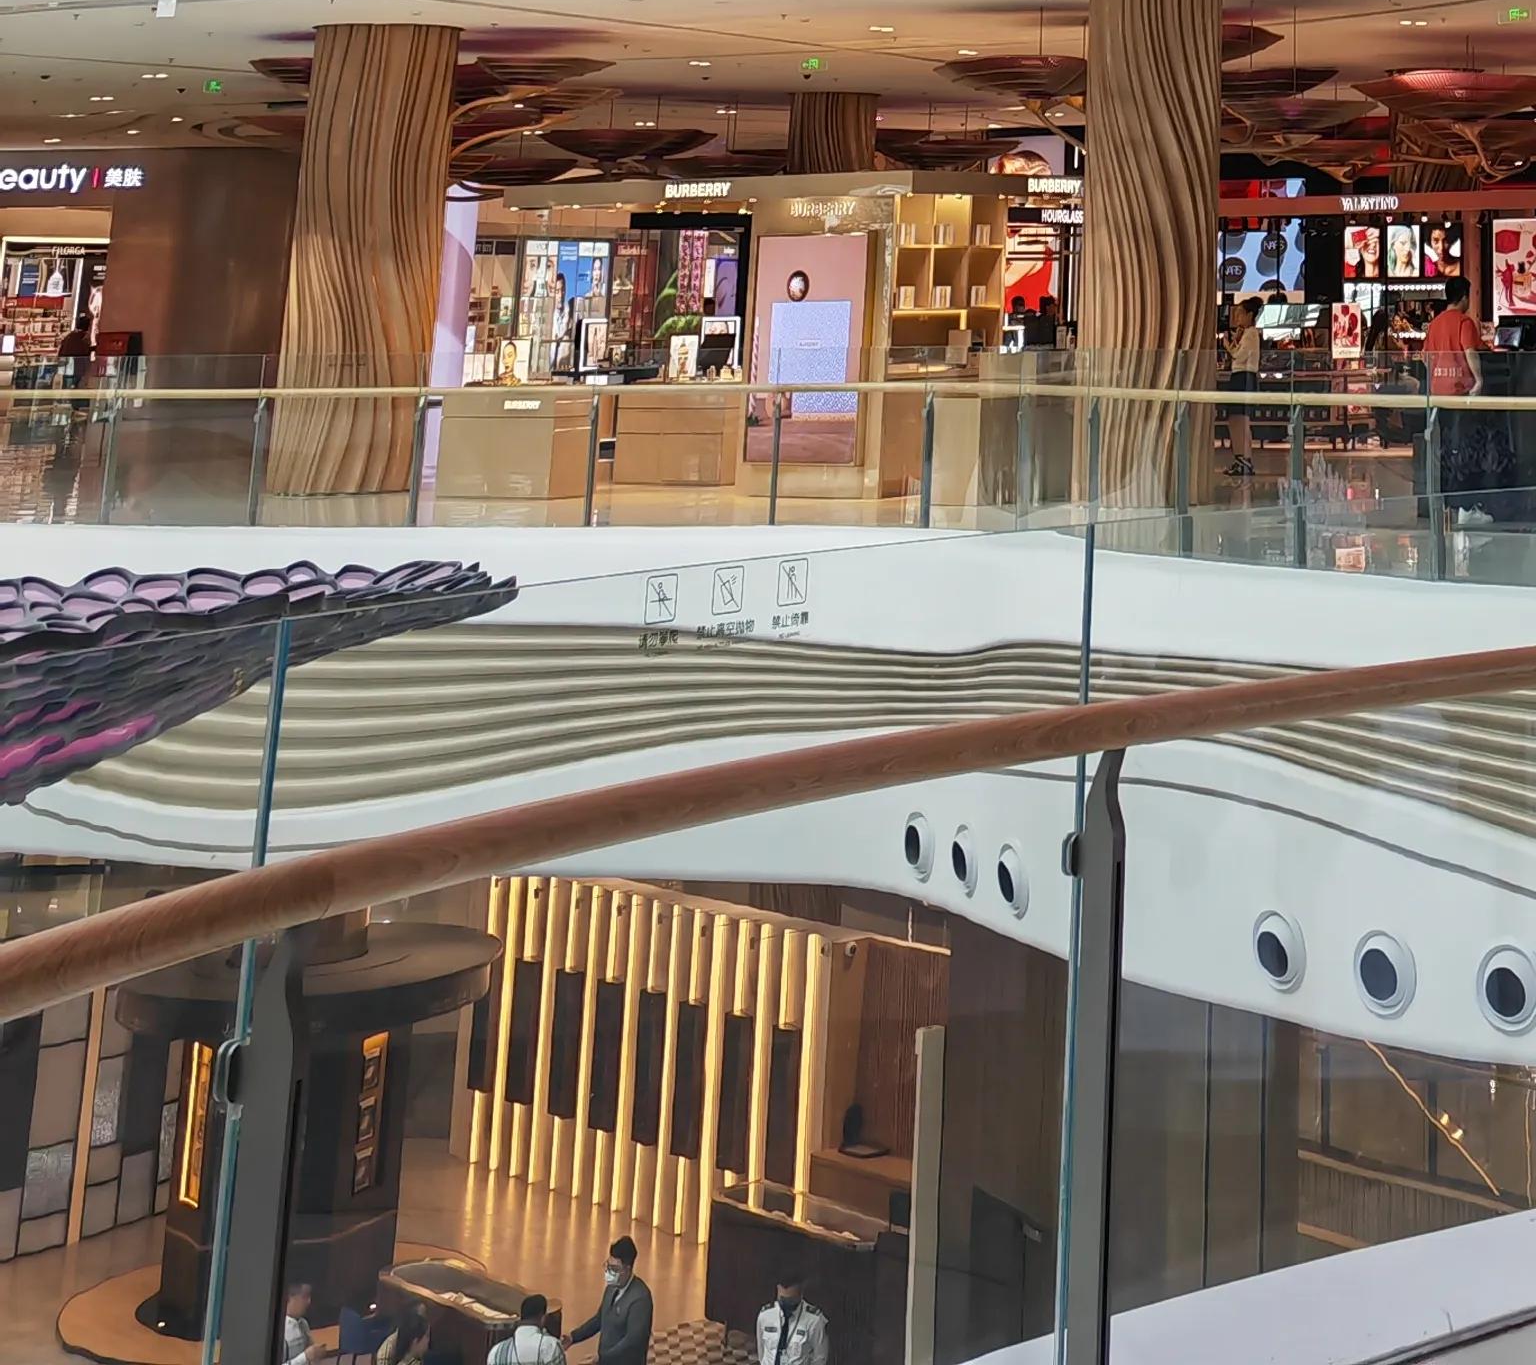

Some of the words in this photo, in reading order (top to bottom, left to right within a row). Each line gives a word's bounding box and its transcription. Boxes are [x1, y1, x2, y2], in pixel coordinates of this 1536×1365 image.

[665, 181, 731, 199] BURBERRY
[1027, 177, 1082, 195] BURBERRY
[790, 200, 857, 217] BURBERRY
[1340, 196, 1399, 211] VALENTINO
[1041, 209, 1084, 223] HOURGLASS
